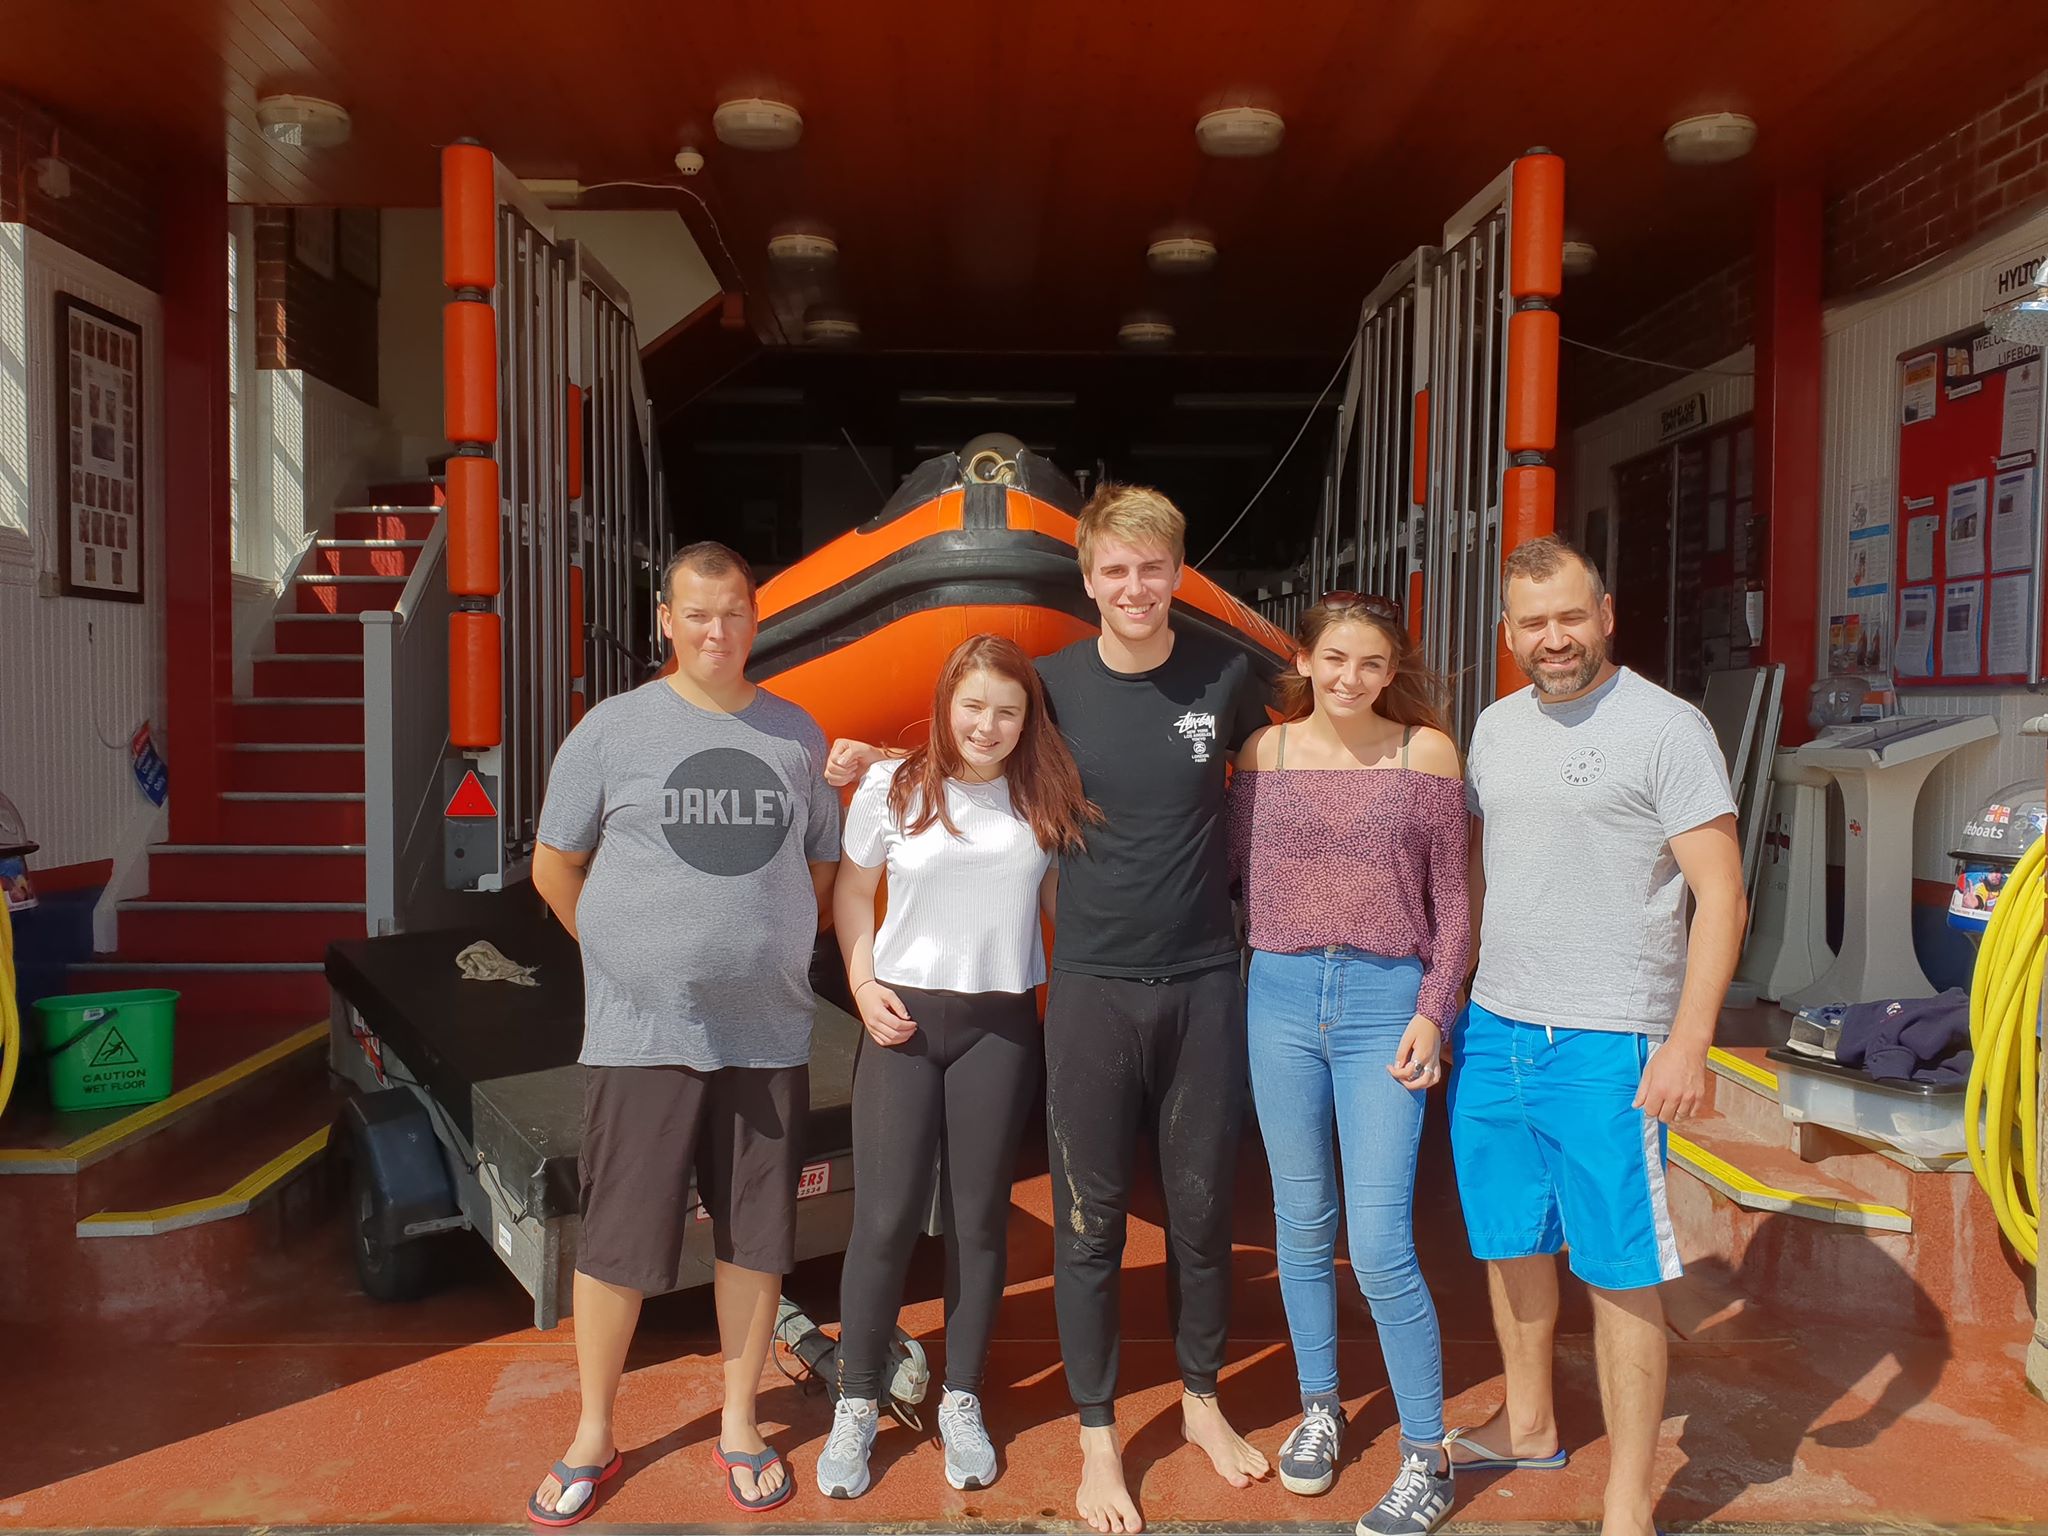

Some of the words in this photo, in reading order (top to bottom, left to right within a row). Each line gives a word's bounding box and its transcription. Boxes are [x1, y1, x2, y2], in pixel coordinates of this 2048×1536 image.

[1998, 255, 2047, 295] HYLTO
[1974, 334, 2007, 353] WELC
[1998, 345, 2039, 366] LIFEBOA
[658, 787, 794, 827] OAKLEY
[82, 1068, 147, 1083] CAUTION
[83, 1083, 108, 1094] WET
[111, 1080, 146, 1091] FLOOR
[800, 1170, 825, 1188] ERS
